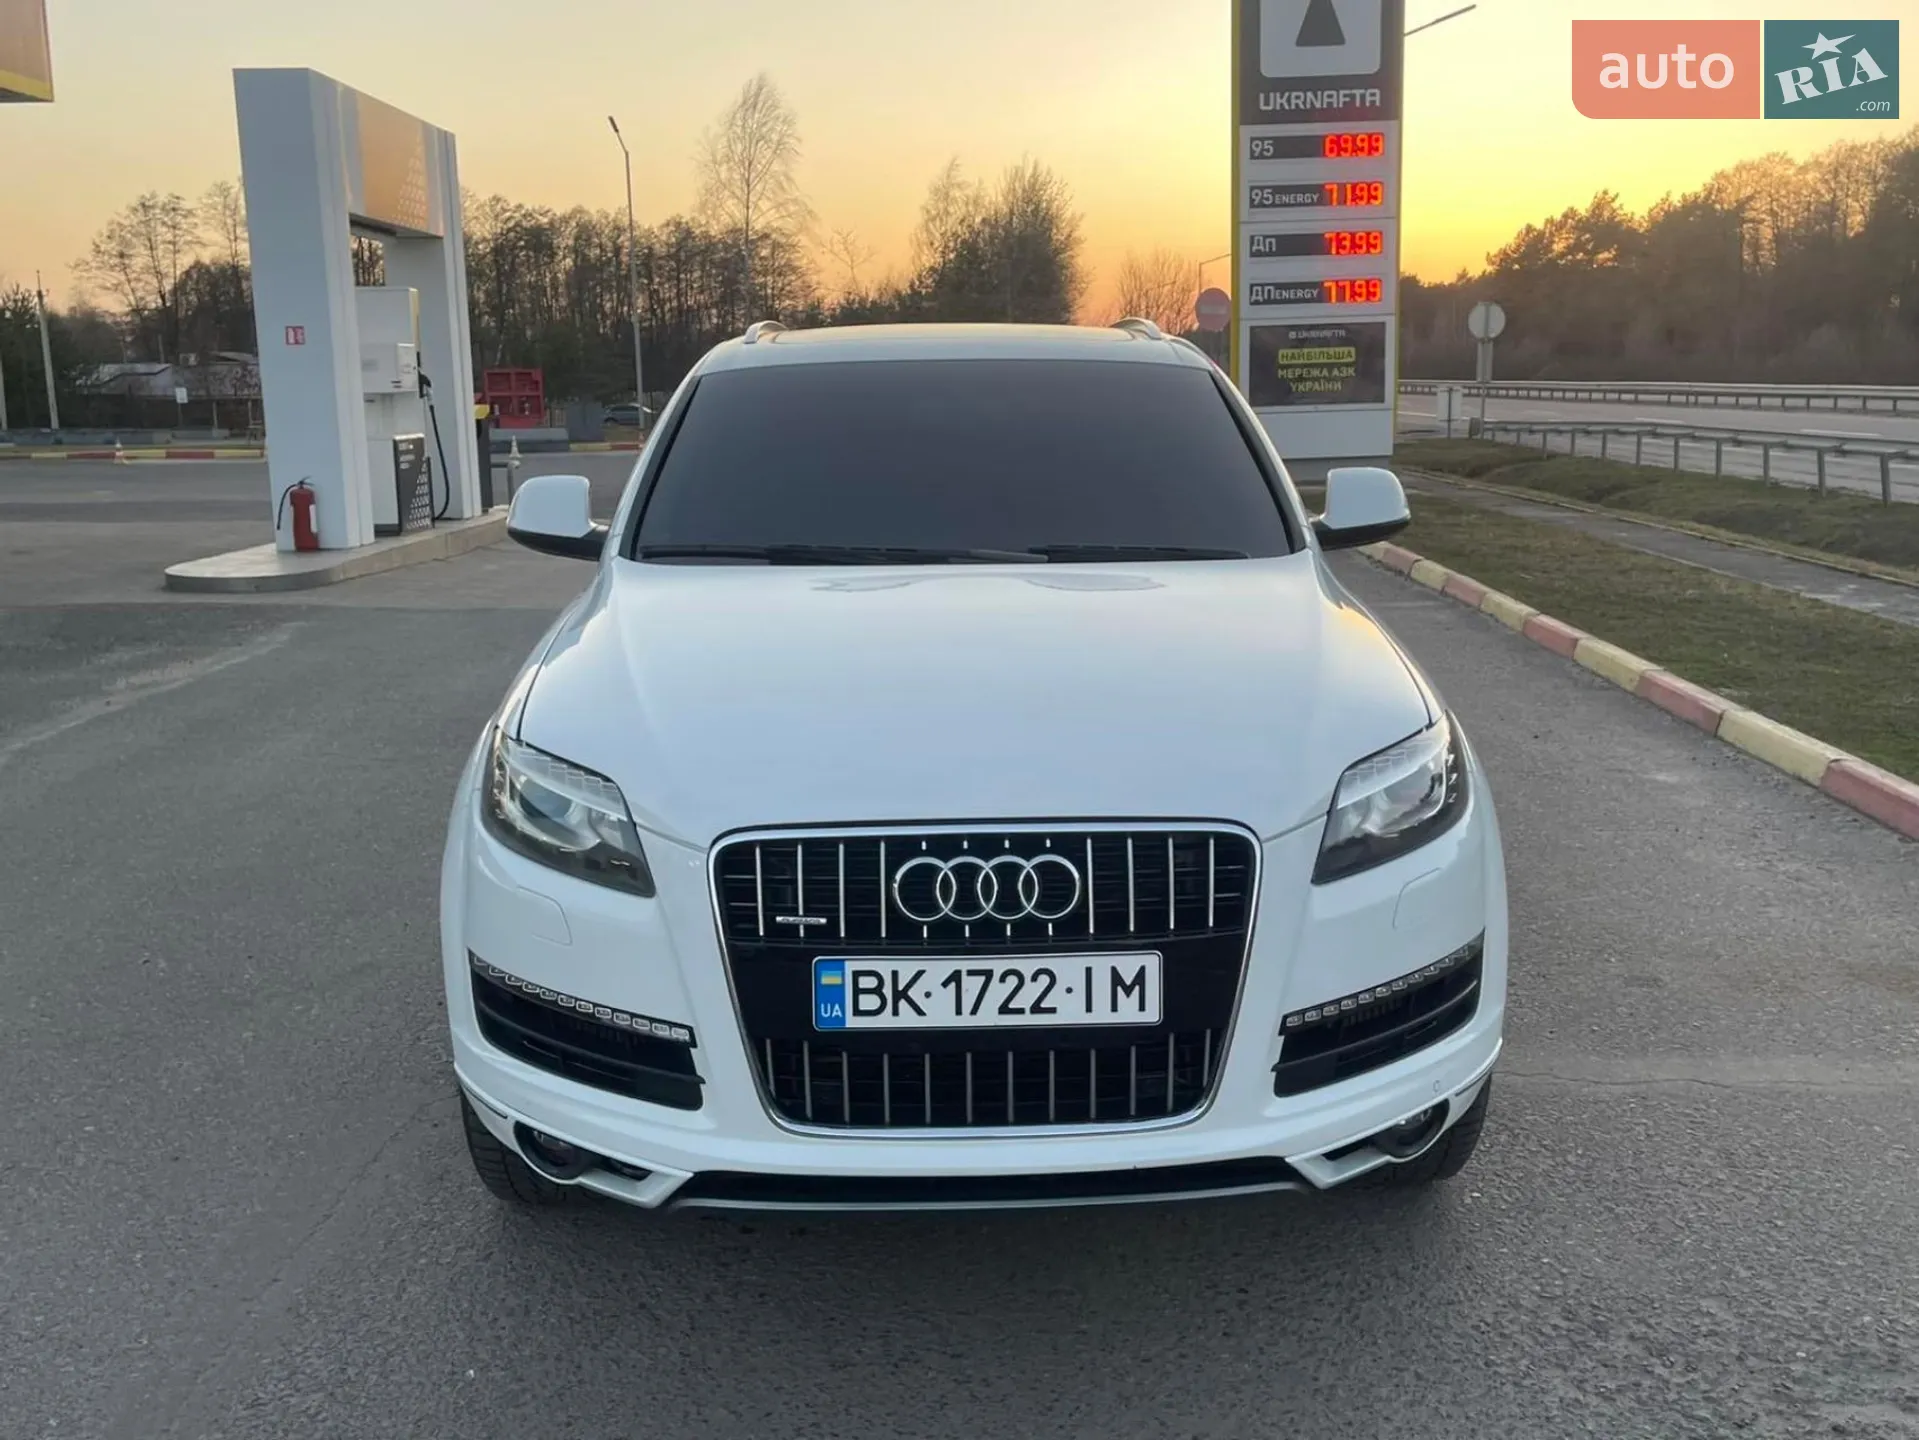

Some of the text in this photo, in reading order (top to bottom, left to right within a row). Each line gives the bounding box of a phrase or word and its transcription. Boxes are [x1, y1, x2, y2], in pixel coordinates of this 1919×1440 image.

[1259, 88, 1381, 110] UKRNAFTA
[1251, 133, 1384, 157] 95 69.99
[1324, 183, 1383, 206] 71.99
[1324, 232, 1382, 255] 73.99
[1280, 349, 1354, 362] НАЙБІЛЬША
[1278, 366, 1356, 379] МЕРЕЖА АЗК
[1289, 379, 1342, 392] УКРАЇНИ
[821, 1003, 842, 1018] UA
